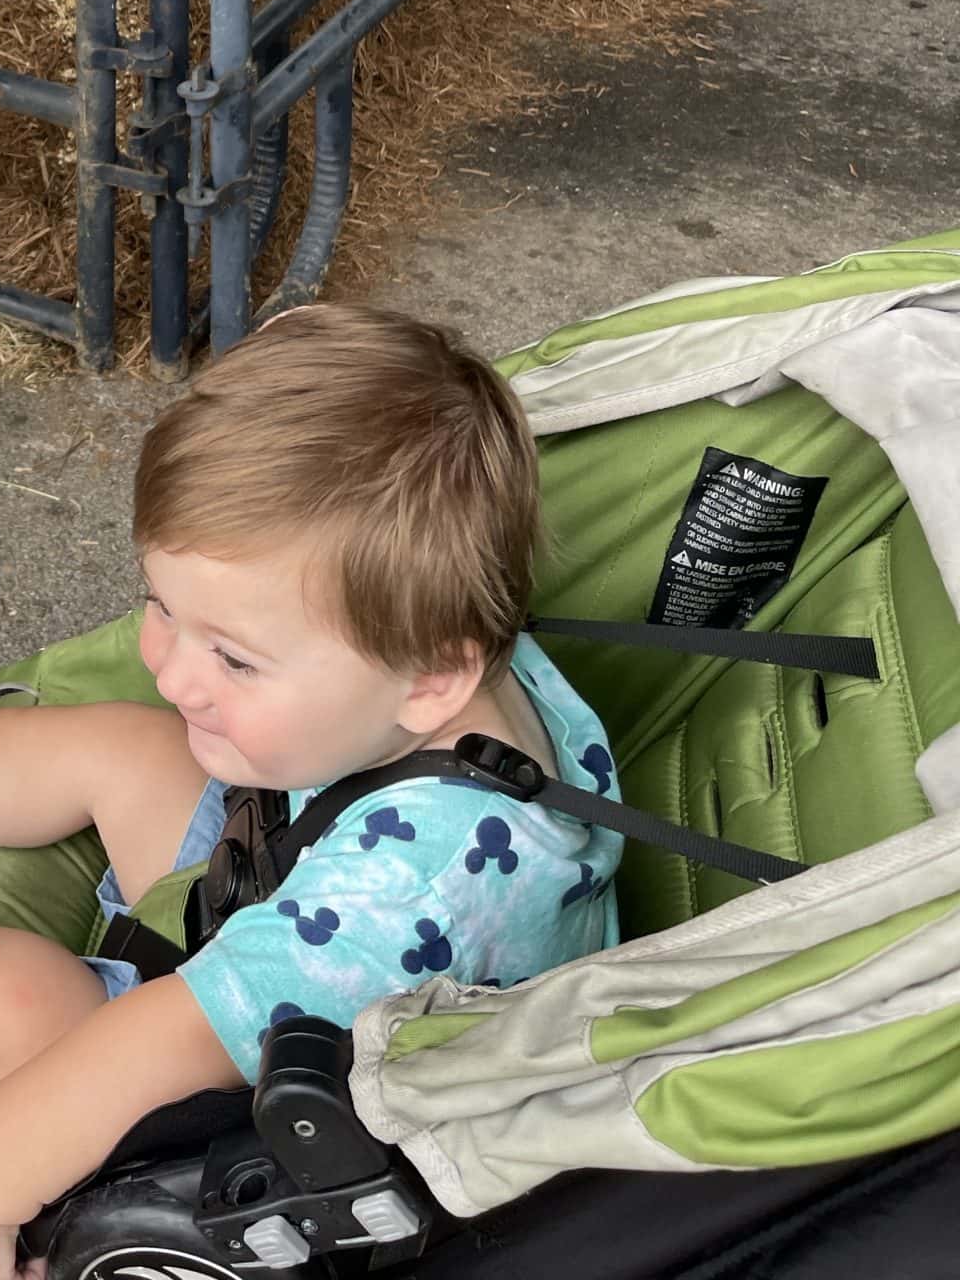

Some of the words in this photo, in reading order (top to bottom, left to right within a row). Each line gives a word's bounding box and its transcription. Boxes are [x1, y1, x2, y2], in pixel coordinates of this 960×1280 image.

[743, 467, 805, 497] WARNING:
[695, 558, 727, 576] MISE
[728, 566, 744, 576] EN
